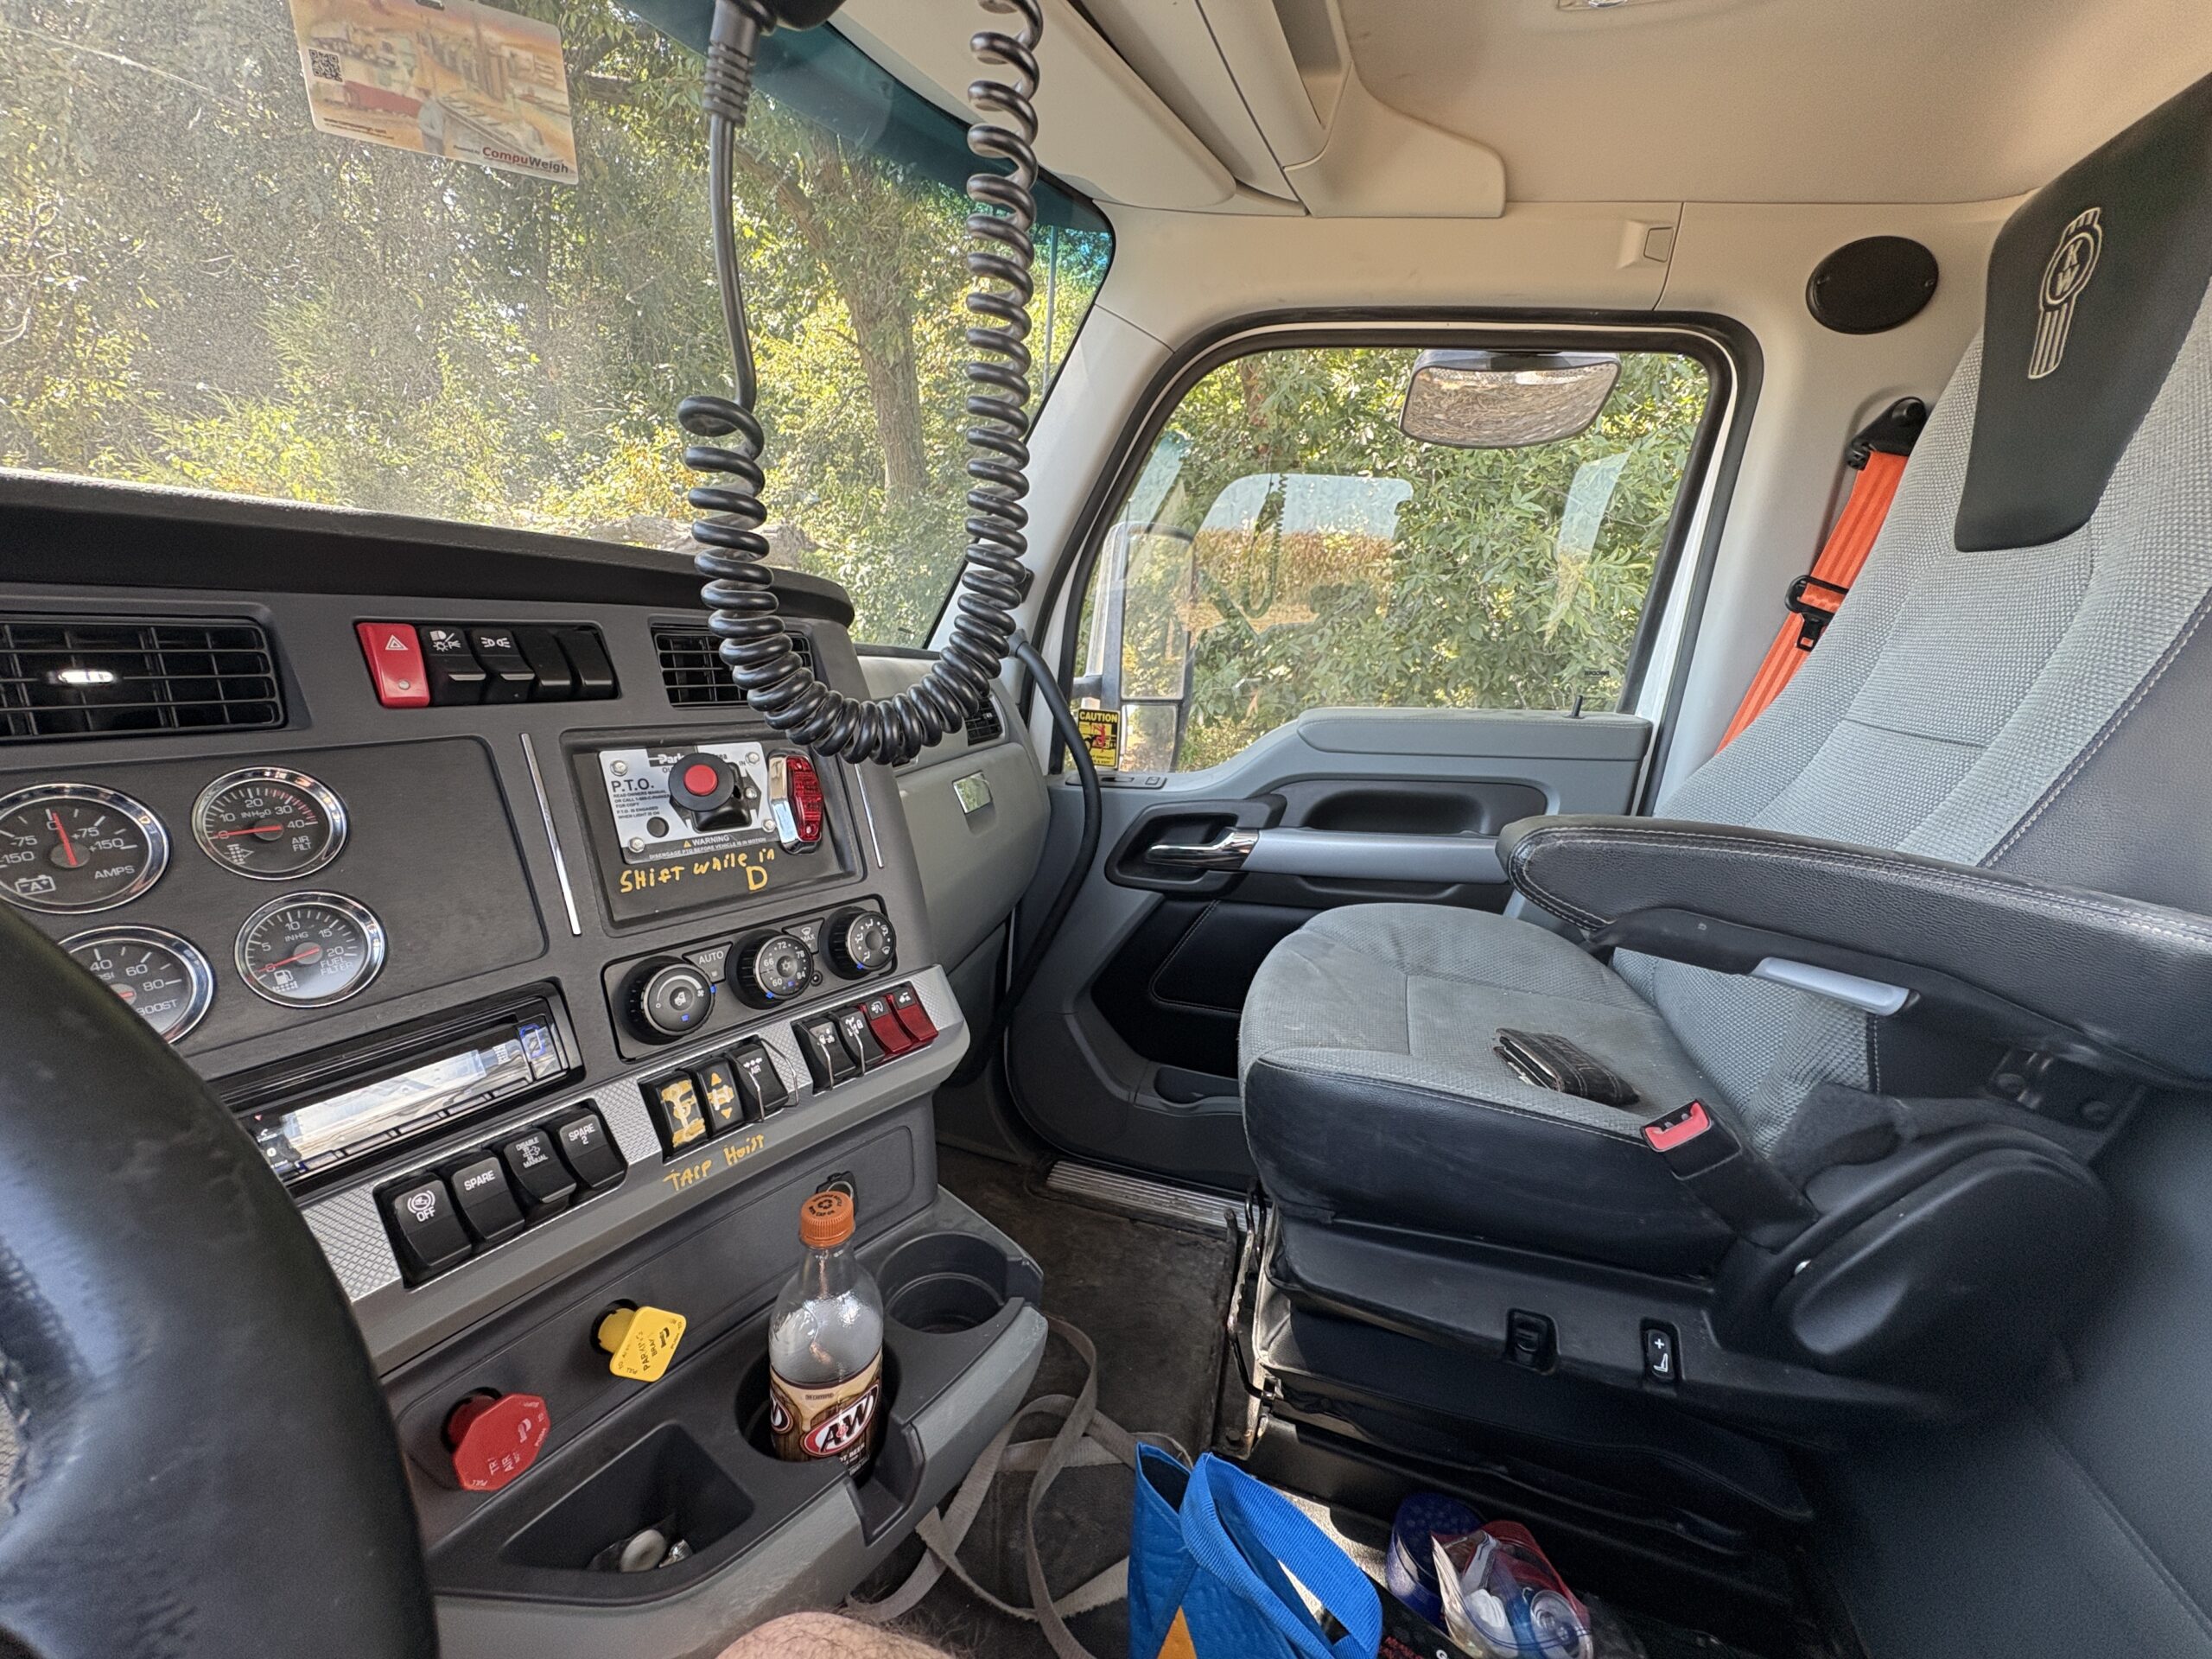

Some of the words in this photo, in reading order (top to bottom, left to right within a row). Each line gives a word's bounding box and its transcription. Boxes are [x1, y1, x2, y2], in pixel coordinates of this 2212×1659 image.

[482, 146, 569, 173] CompuWeigh
[1079, 711, 1118, 722] CAUTION
[611, 778, 654, 792] P.T.O.
[245, 798, 264, 808] 20
[275, 805, 292, 815] 30
[219, 813, 236, 822] 10
[288, 820, 305, 829] 40
[292, 836, 309, 844] AIR
[692, 835, 729, 847] WARNING
[293, 842, 311, 852] FILT
[649, 849, 682, 860] DISENGAGE
[94, 866, 135, 880] AMPS
[746, 865, 768, 891] D
[285, 921, 300, 931] 10
[296, 931, 308, 940] HG
[319, 929, 333, 938] 15
[261, 942, 271, 951] 5
[777, 941, 787, 950] 72
[327, 946, 344, 957] 20
[699, 950, 724, 964] AUTO
[796, 950, 805, 959] 78
[90, 959, 112, 971] 40
[321, 957, 346, 968] FUEL
[764, 958, 774, 967] 66
[125, 964, 148, 976] 60
[321, 962, 353, 976] FILTER
[797, 970, 806, 980] 84
[143, 979, 164, 991] 80
[772, 978, 783, 987] 60
[750, 1065, 762, 1075] AIR
[569, 1123, 595, 1141] SPARE
[516, 1136, 540, 1152] DISABLE
[581, 1136, 589, 1145] 2
[523, 1154, 549, 1169] MANUAL
[463, 1170, 496, 1192] SPARE
[416, 1206, 436, 1223] OFF
